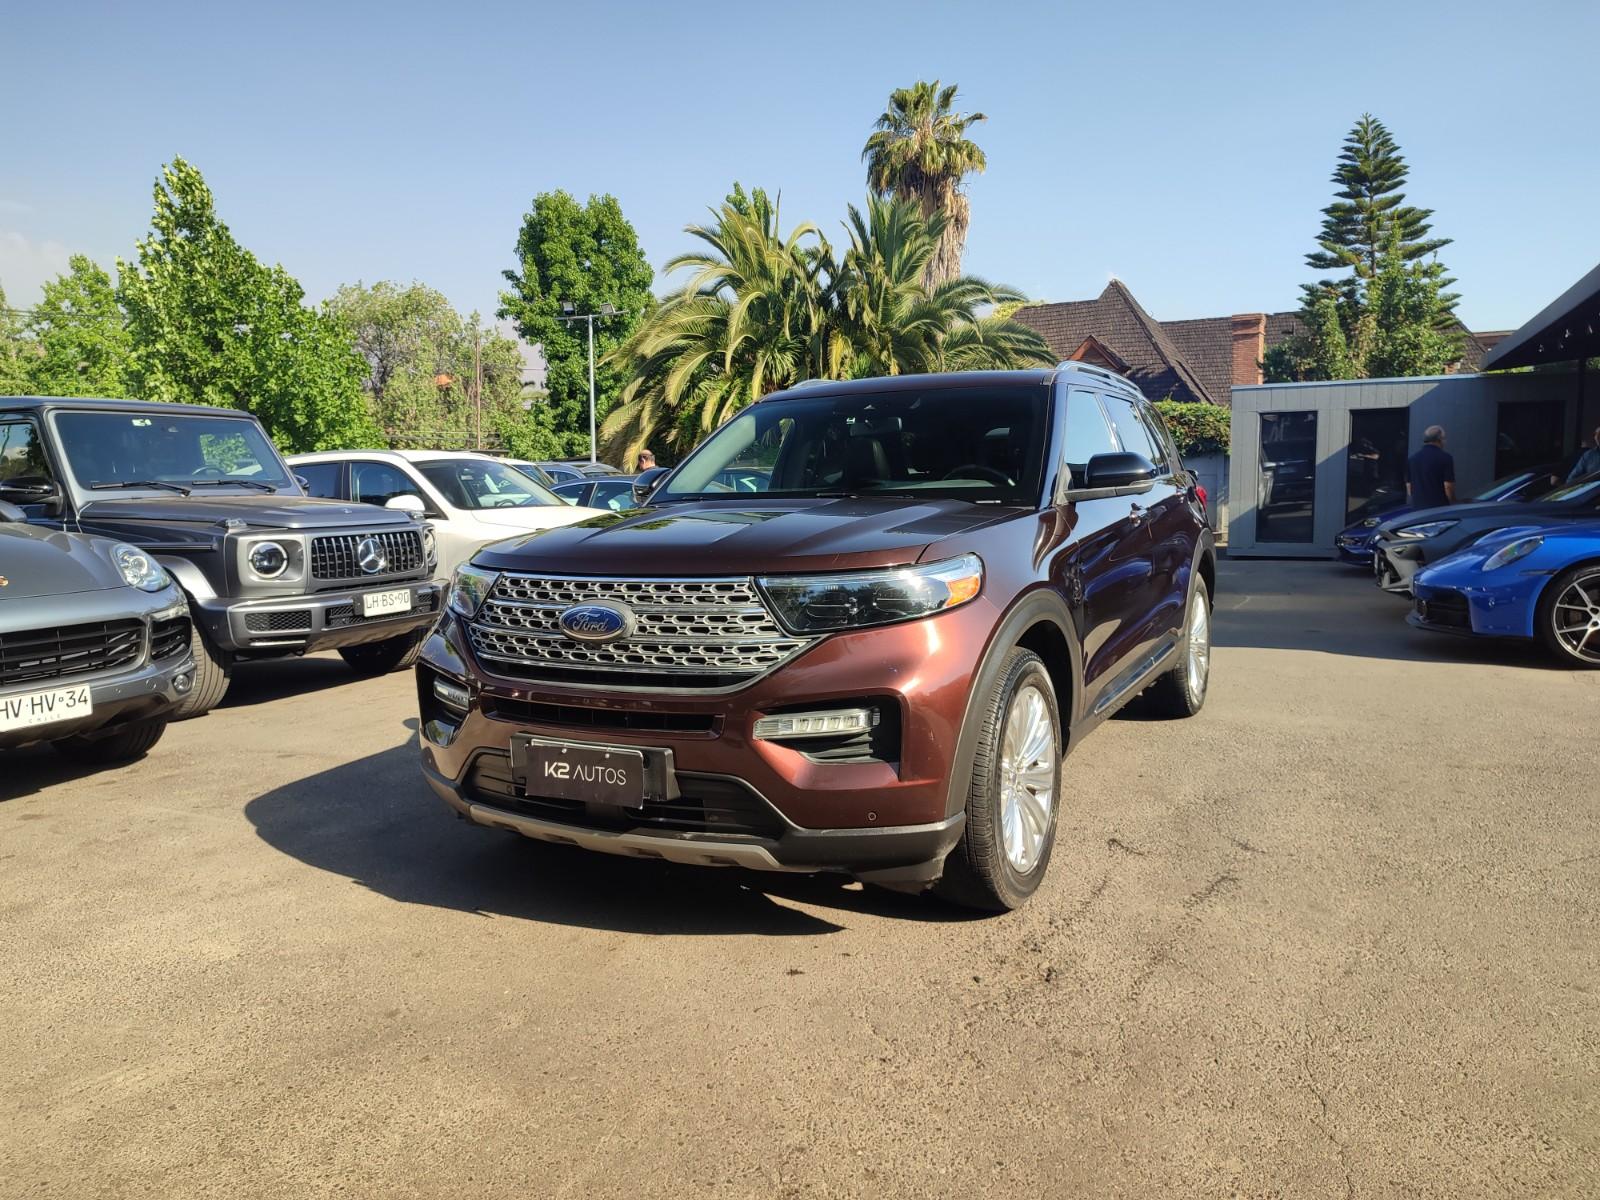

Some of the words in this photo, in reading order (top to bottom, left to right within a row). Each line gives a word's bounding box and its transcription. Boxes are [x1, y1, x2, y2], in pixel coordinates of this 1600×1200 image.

[567, 610, 610, 632] Ford
[544, 760, 570, 780] K2
[572, 763, 627, 786] AUTOS
